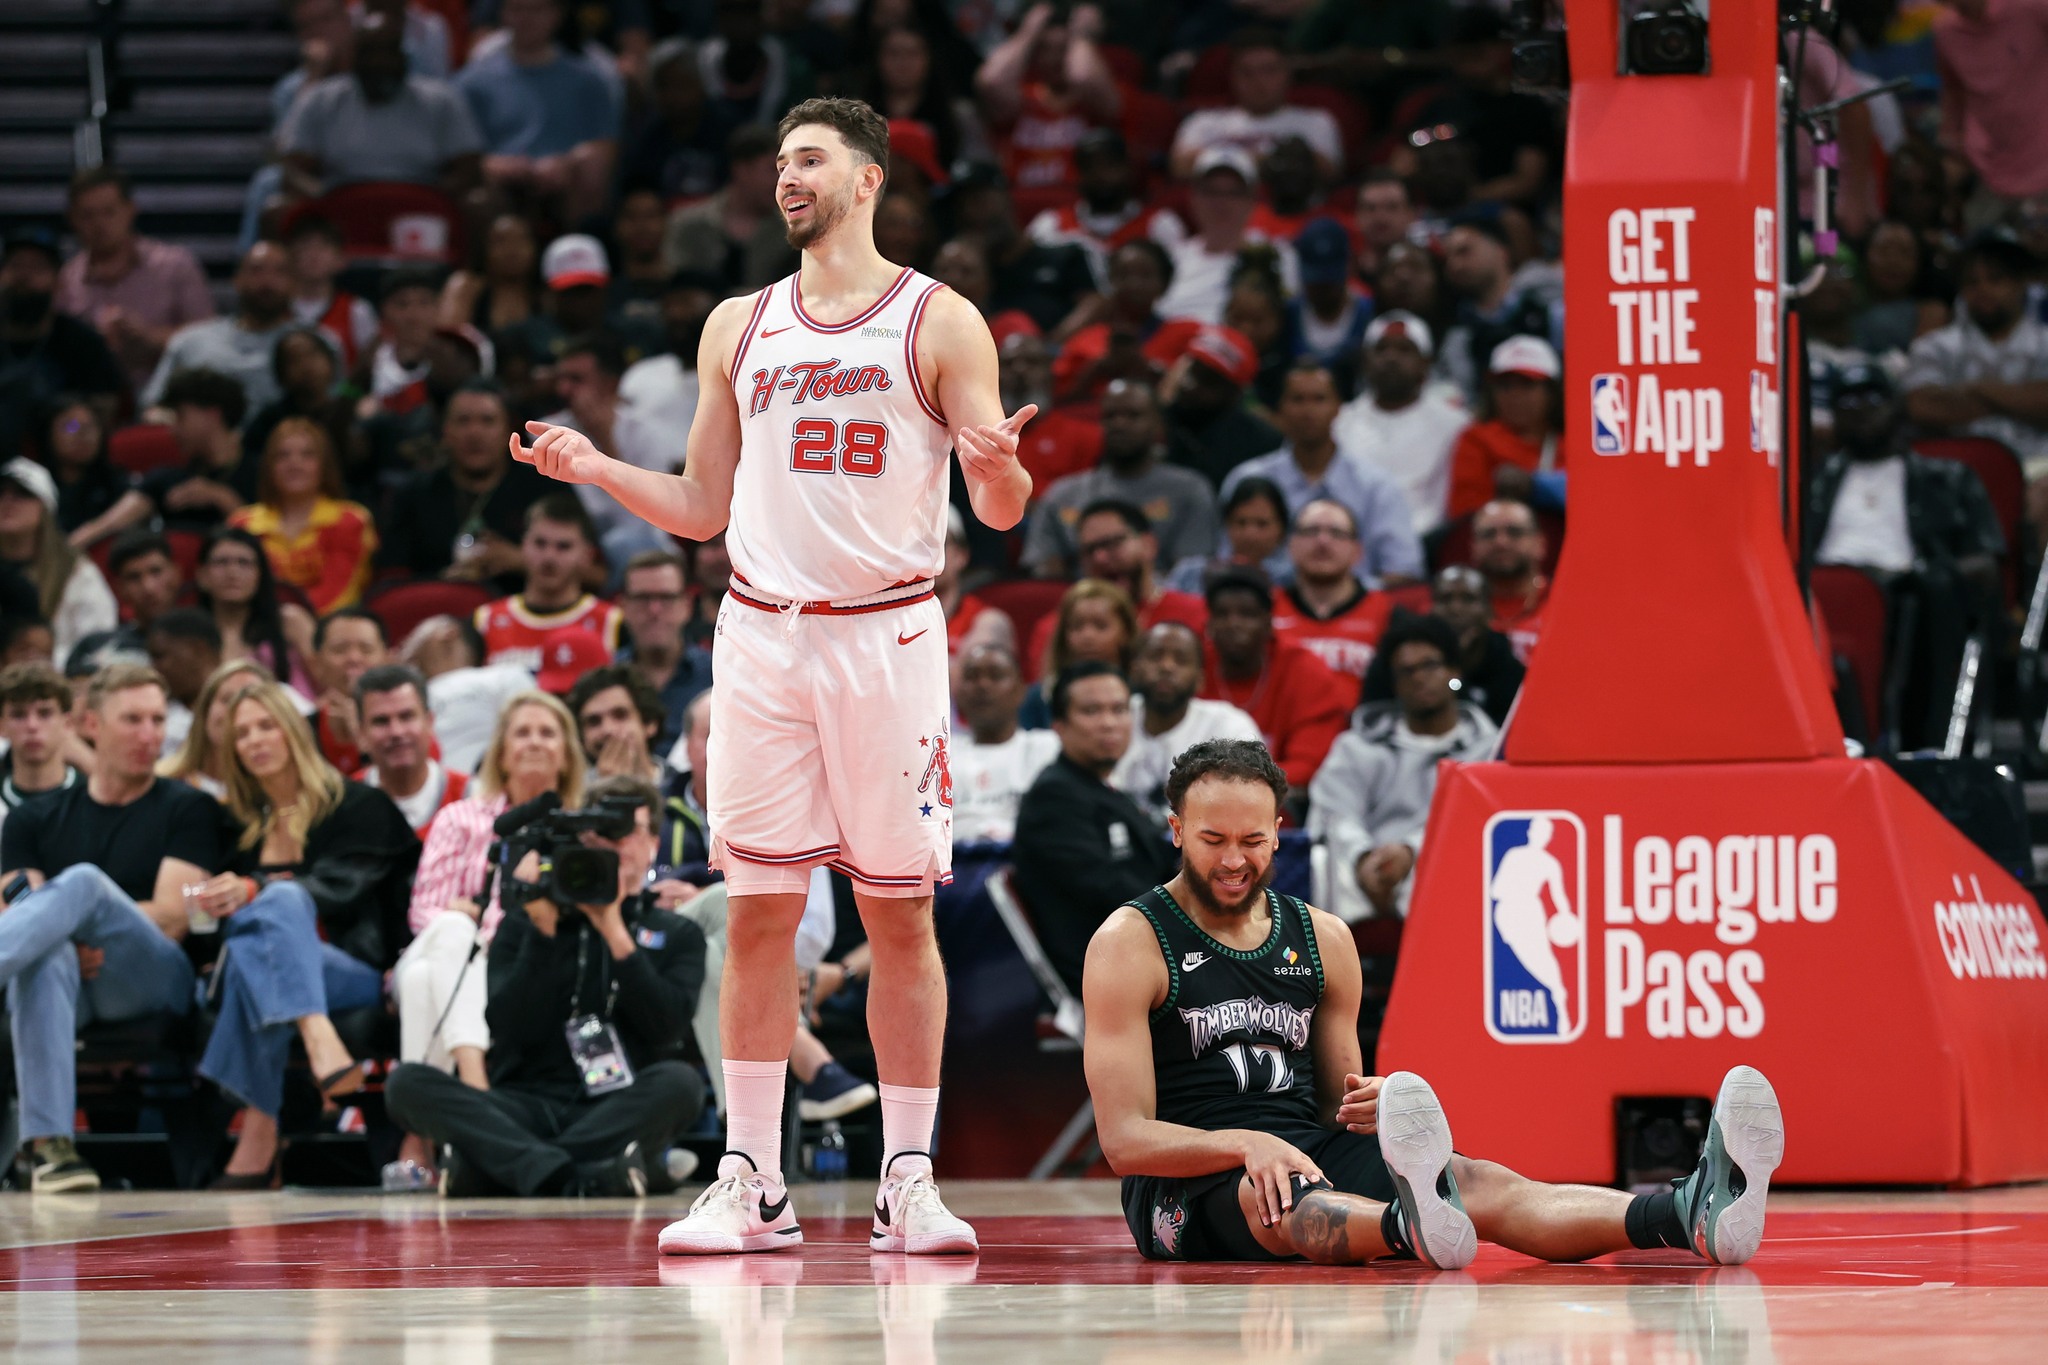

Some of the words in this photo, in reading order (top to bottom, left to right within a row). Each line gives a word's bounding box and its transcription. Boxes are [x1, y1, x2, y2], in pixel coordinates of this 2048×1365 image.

[1608, 207, 1695, 284] GET
[1608, 289, 1701, 366] THE
[750, 357, 893, 418] H-Town
[1634, 373, 1724, 467] App
[789, 416, 889, 478] 28
[1603, 814, 1838, 945] League
[1185, 951, 1204, 964] NIKE
[1933, 872, 2047, 980] coinbase
[1273, 964, 1312, 976] sezzle
[1604, 928, 1766, 1039] Pass
[1500, 989, 1549, 1028] NBA
[1218, 1042, 1295, 1094] 12
